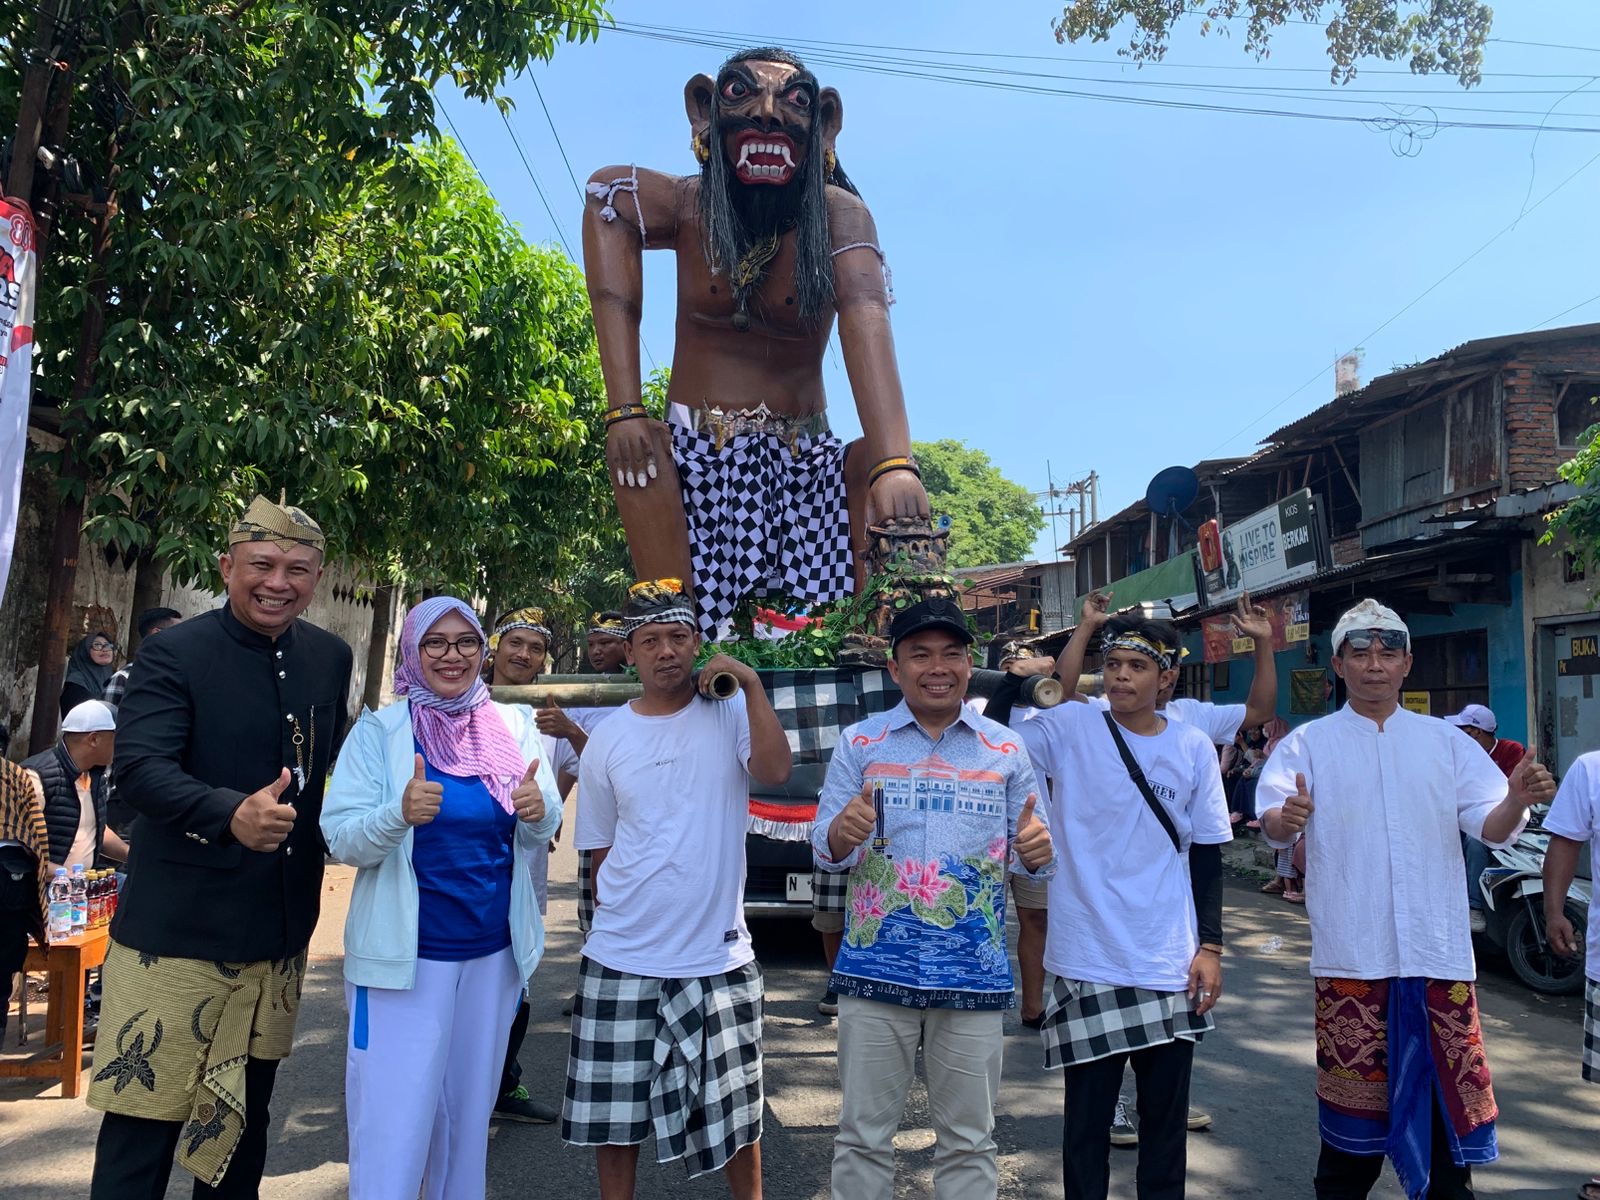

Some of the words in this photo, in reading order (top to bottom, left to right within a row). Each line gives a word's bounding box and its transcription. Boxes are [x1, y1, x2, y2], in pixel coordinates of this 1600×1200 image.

[1285, 504, 1298, 517] KIOS
[1239, 527, 1261, 551] LIVE
[1262, 520, 1277, 542] TO
[1282, 526, 1308, 550] BERKAH
[1239, 541, 1276, 569] INSPIRE
[1573, 638, 1597, 657] BUKA
[1150, 782, 1175, 800] REW
[789, 876, 797, 891] N
